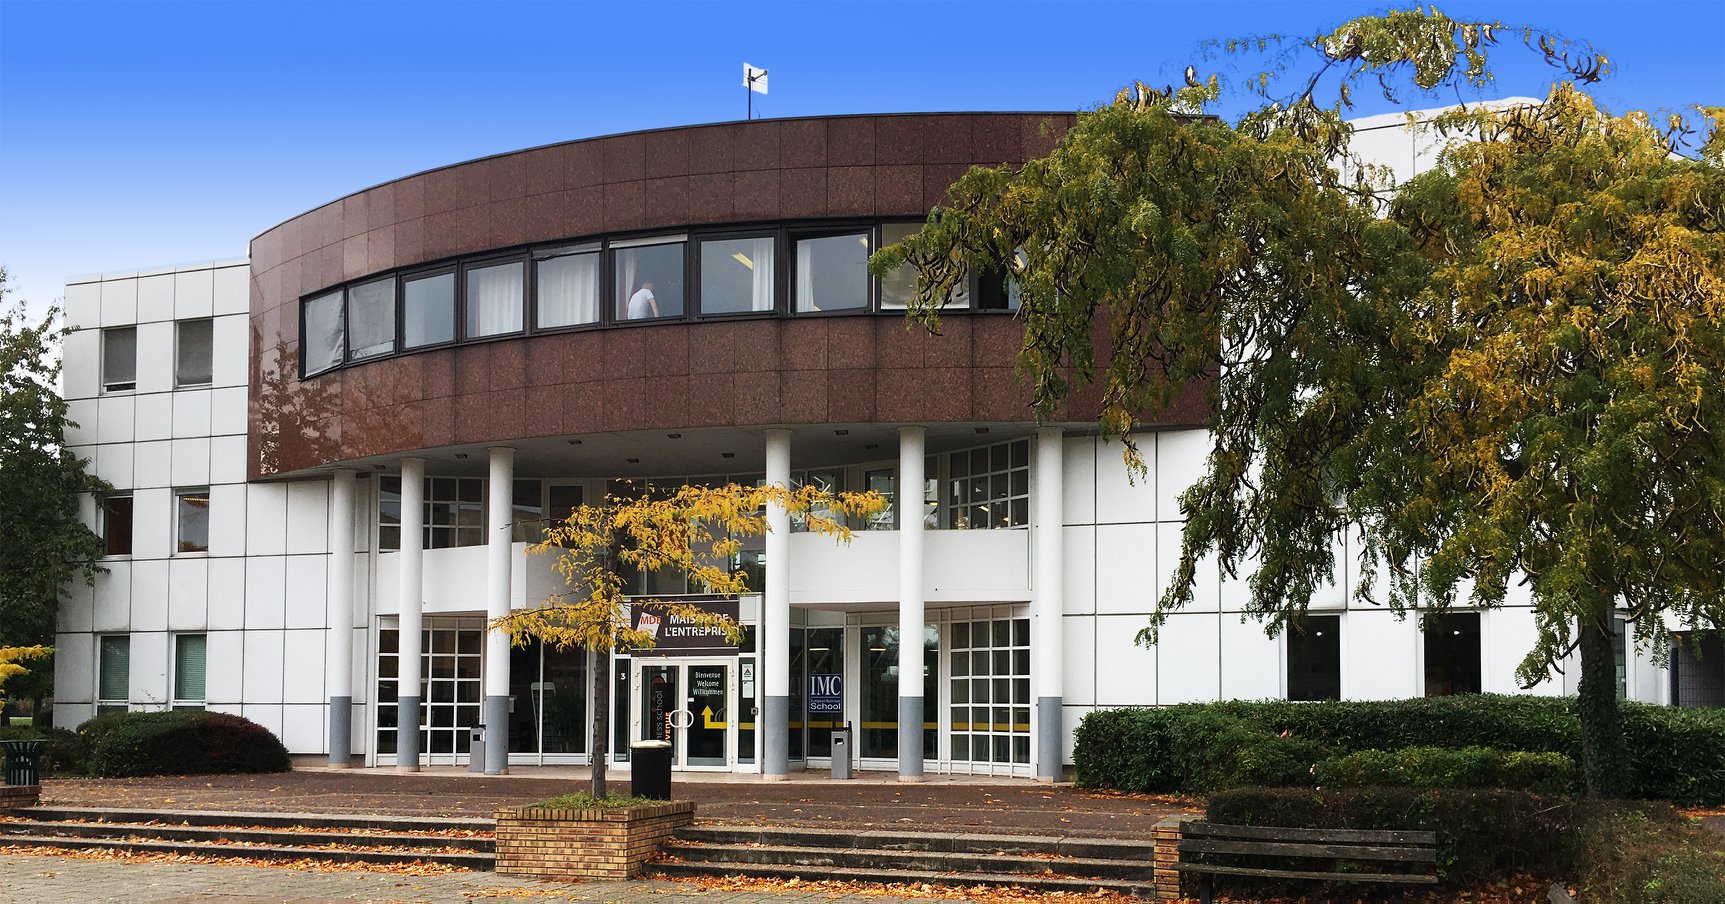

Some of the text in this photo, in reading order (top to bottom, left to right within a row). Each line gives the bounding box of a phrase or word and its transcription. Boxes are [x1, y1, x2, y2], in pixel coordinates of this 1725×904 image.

[640, 616, 662, 625] MDE
[670, 614, 708, 625] MAIS
[665, 627, 729, 637] L'ENTREPRIS
[810, 676, 840, 696] IMC
[692, 688, 724, 696] Willkommen
